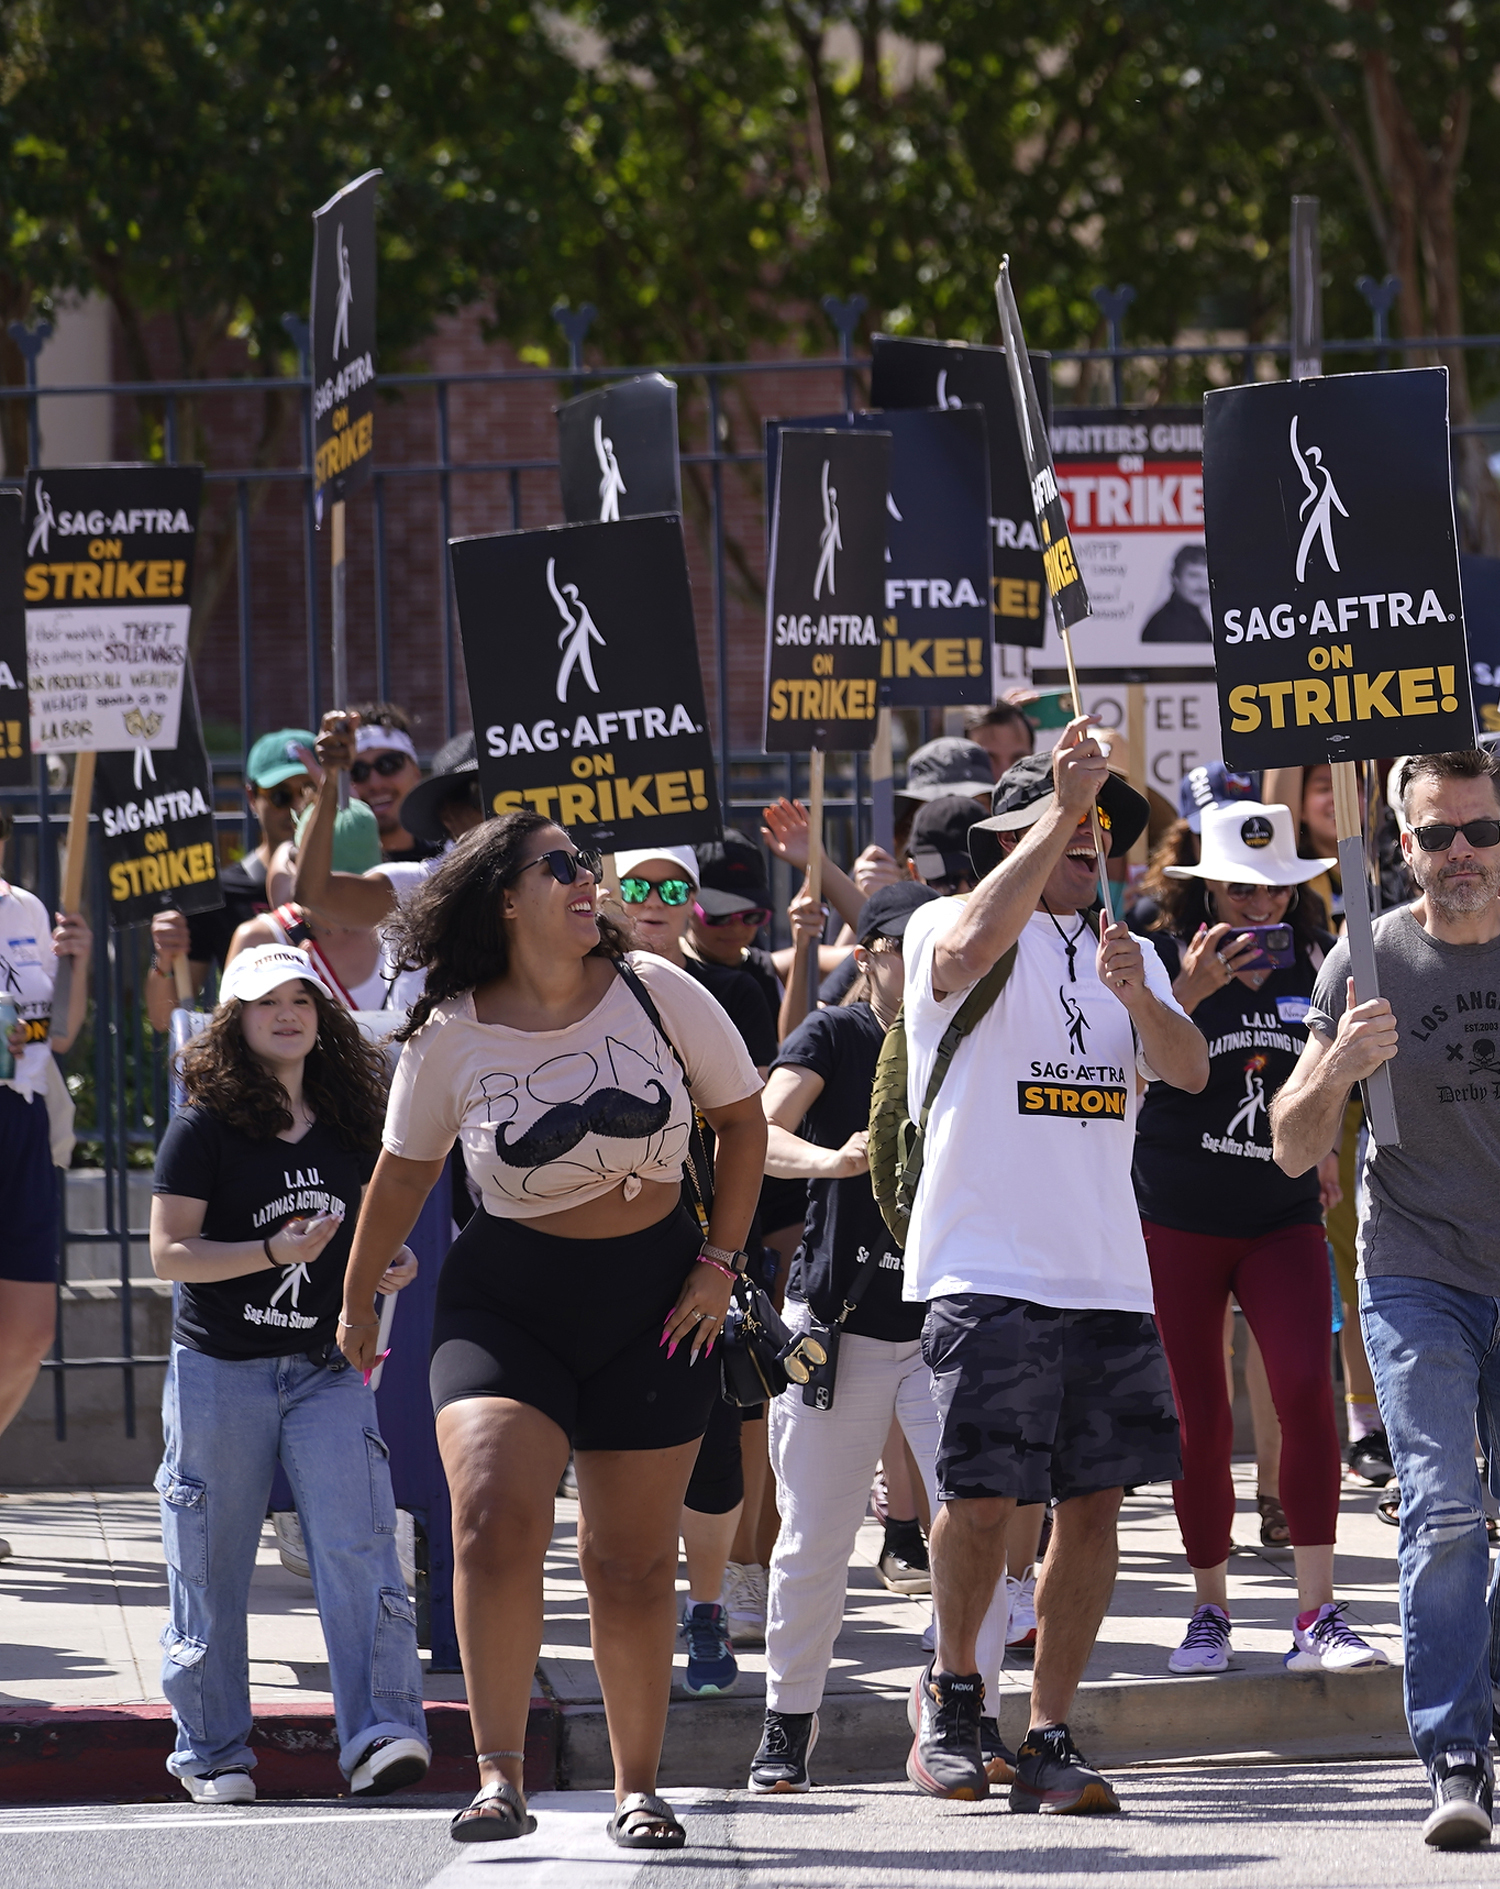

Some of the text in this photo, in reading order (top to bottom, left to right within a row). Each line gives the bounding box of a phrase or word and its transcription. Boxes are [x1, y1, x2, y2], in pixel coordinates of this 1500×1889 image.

[332, 405, 349, 432] ON
[1118, 454, 1145, 474] ON
[89, 539, 122, 560] ON
[24, 561, 186, 601] STRIKE!
[813, 654, 833, 675] ON
[1308, 645, 1353, 671] ON
[771, 680, 877, 721] STRIKE!
[1229, 665, 1459, 734] STRIKE!
[41, 718, 94, 742] LABOR
[571, 753, 614, 779] ON
[1188, 766, 1220, 812] CHI
[145, 831, 168, 852] ON
[110, 842, 216, 901] STRIKE!
[1241, 1011, 1282, 1029] L.A.U.
[1410, 1004, 1449, 1042] LOS
[1209, 1030, 1252, 1058] LATINAS
[1254, 1030, 1291, 1051] ACTING
[1436, 1085, 1488, 1105] Derby
[1243, 1140, 1272, 1162] Strong
[284, 1167, 325, 1189] L.A.U.
[253, 1193, 295, 1228] LATINAS
[297, 1190, 331, 1212] ACTING
[243, 1303, 288, 1327] Sag-Aftra
[951, 1682, 974, 1692] HOKA
[1043, 1730, 1066, 1740] HOKA
